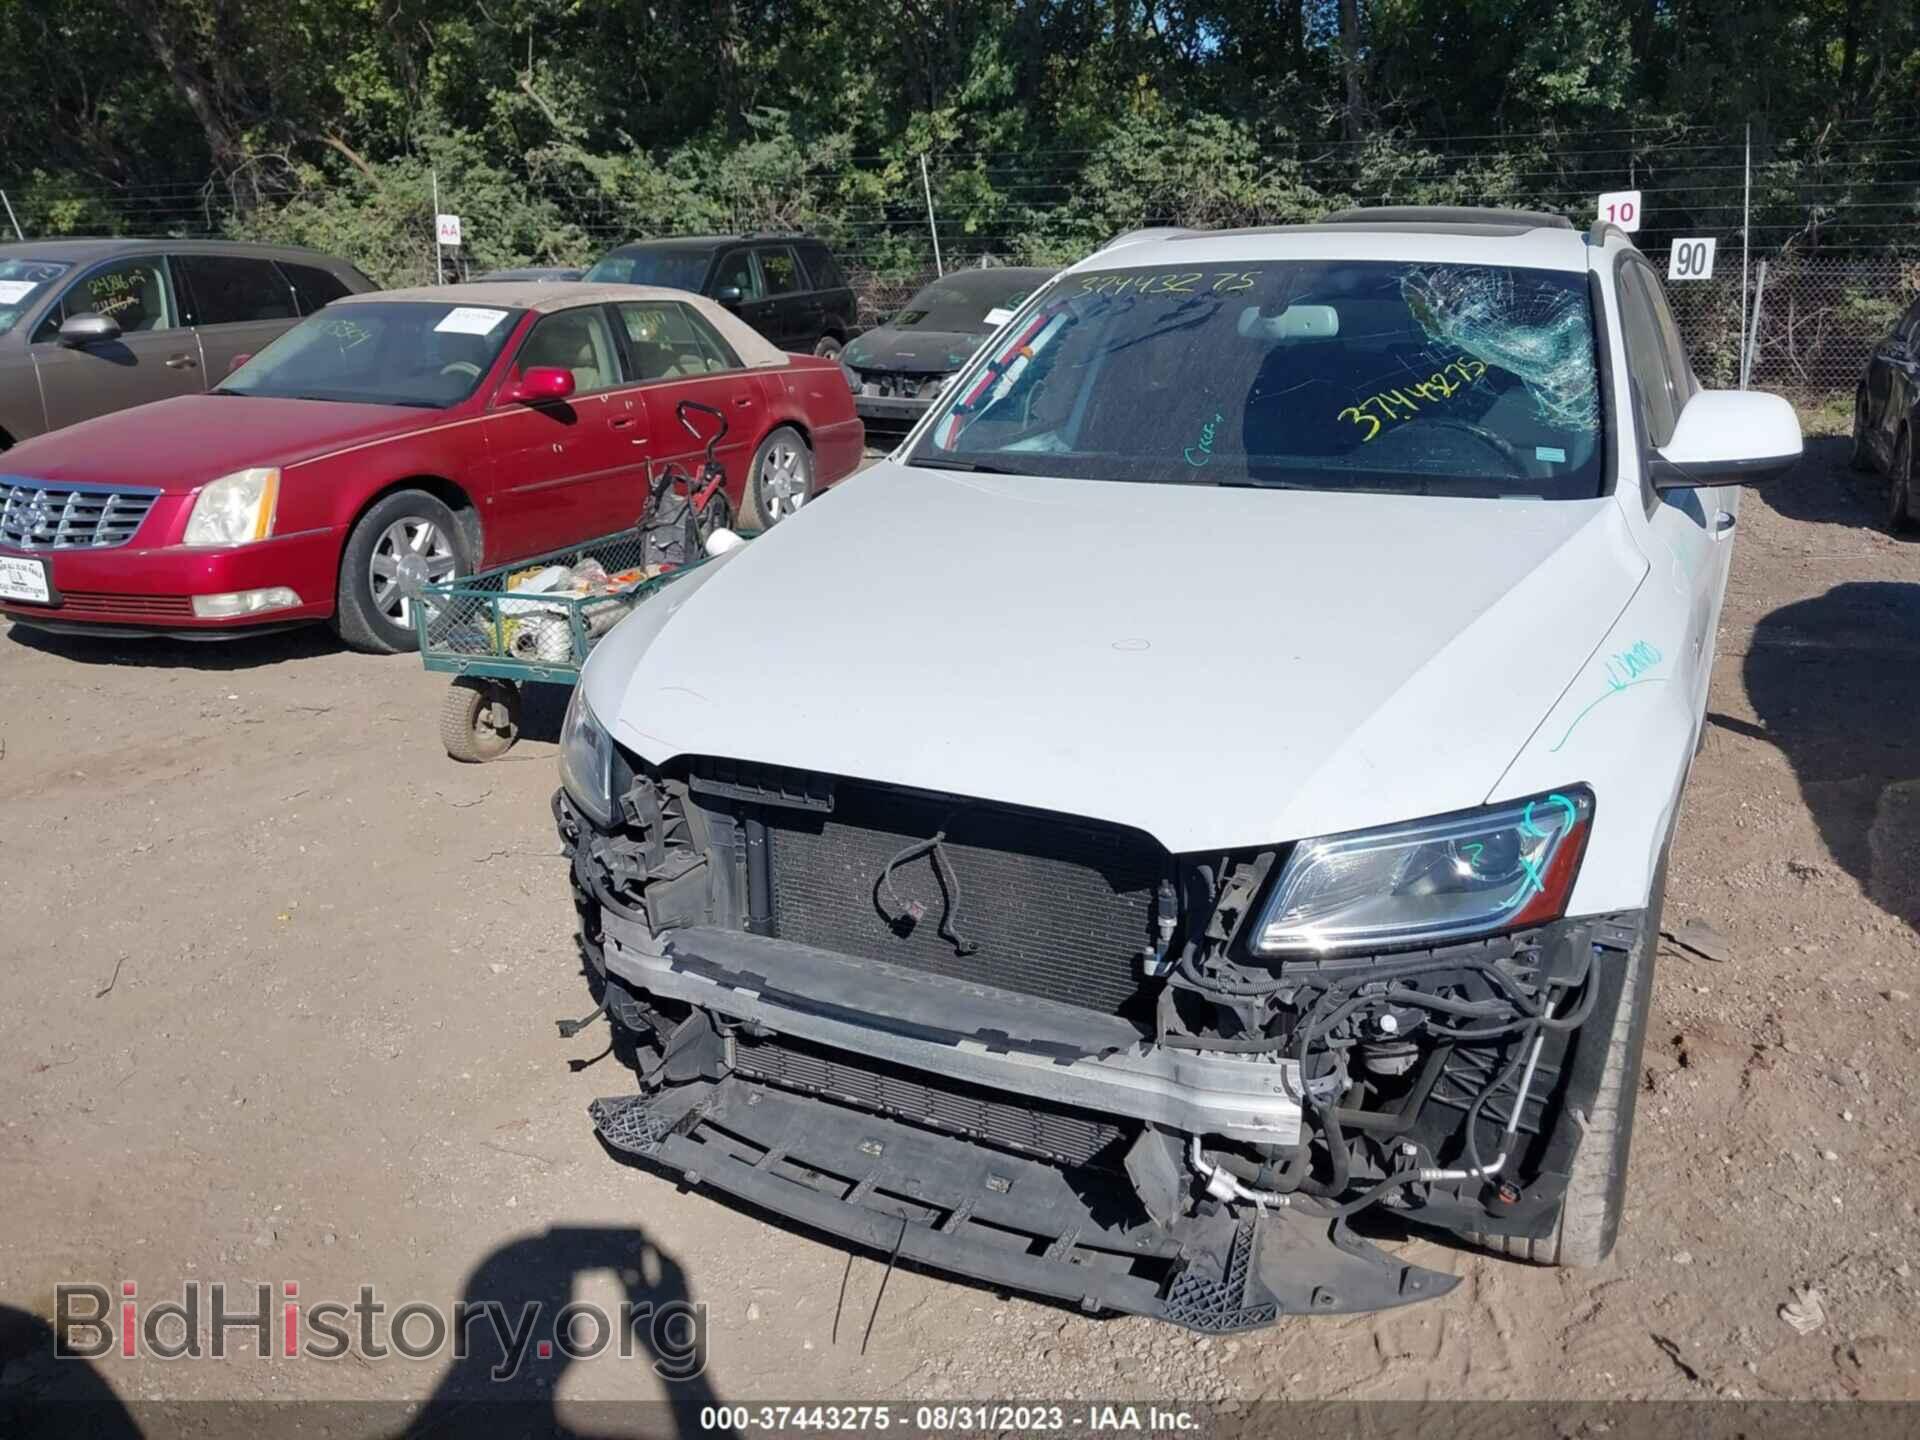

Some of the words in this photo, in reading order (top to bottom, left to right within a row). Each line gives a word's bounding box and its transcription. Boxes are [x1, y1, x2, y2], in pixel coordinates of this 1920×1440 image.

[1606, 203, 1634, 224] 10
[441, 223, 457, 237] AA
[1676, 242, 1707, 277] 90
